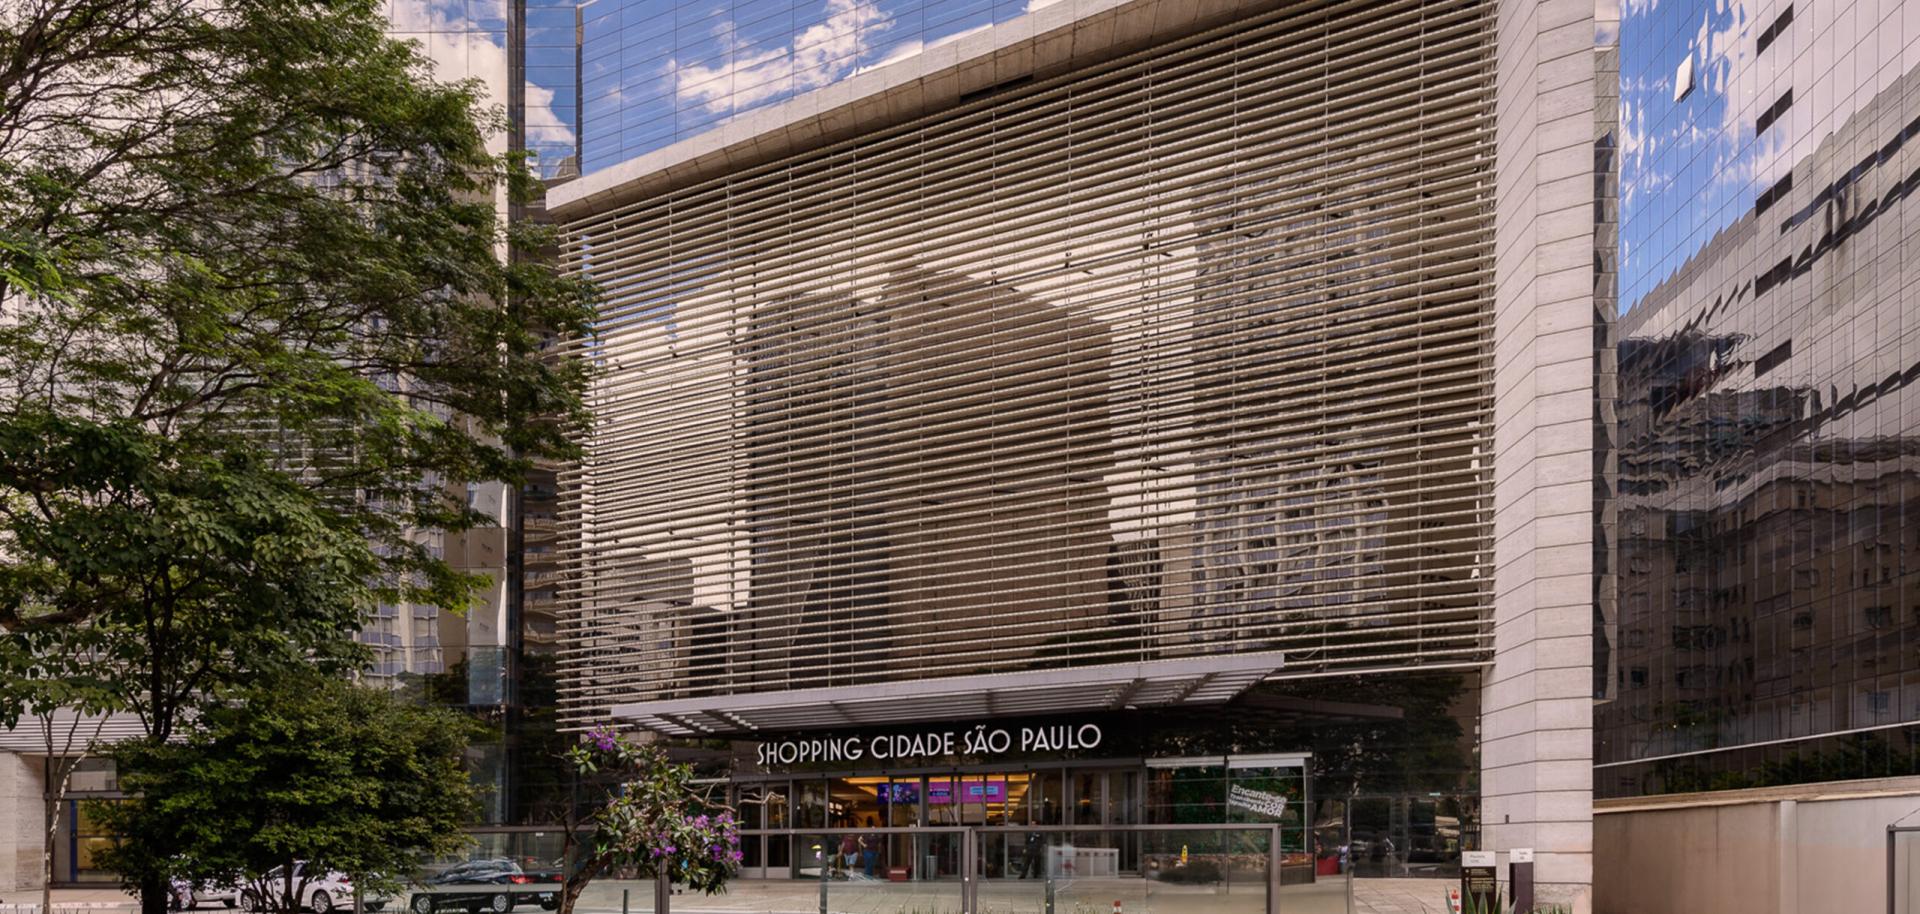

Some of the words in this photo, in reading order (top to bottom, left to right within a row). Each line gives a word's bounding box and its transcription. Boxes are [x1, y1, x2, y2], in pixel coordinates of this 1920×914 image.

[757, 738, 863, 765] SHOPPING
[871, 732, 954, 759] CIDADE
[964, 724, 1011, 755] SÃO
[1022, 723, 1102, 752] PAULO
[1249, 804, 1282, 818] AMOR
